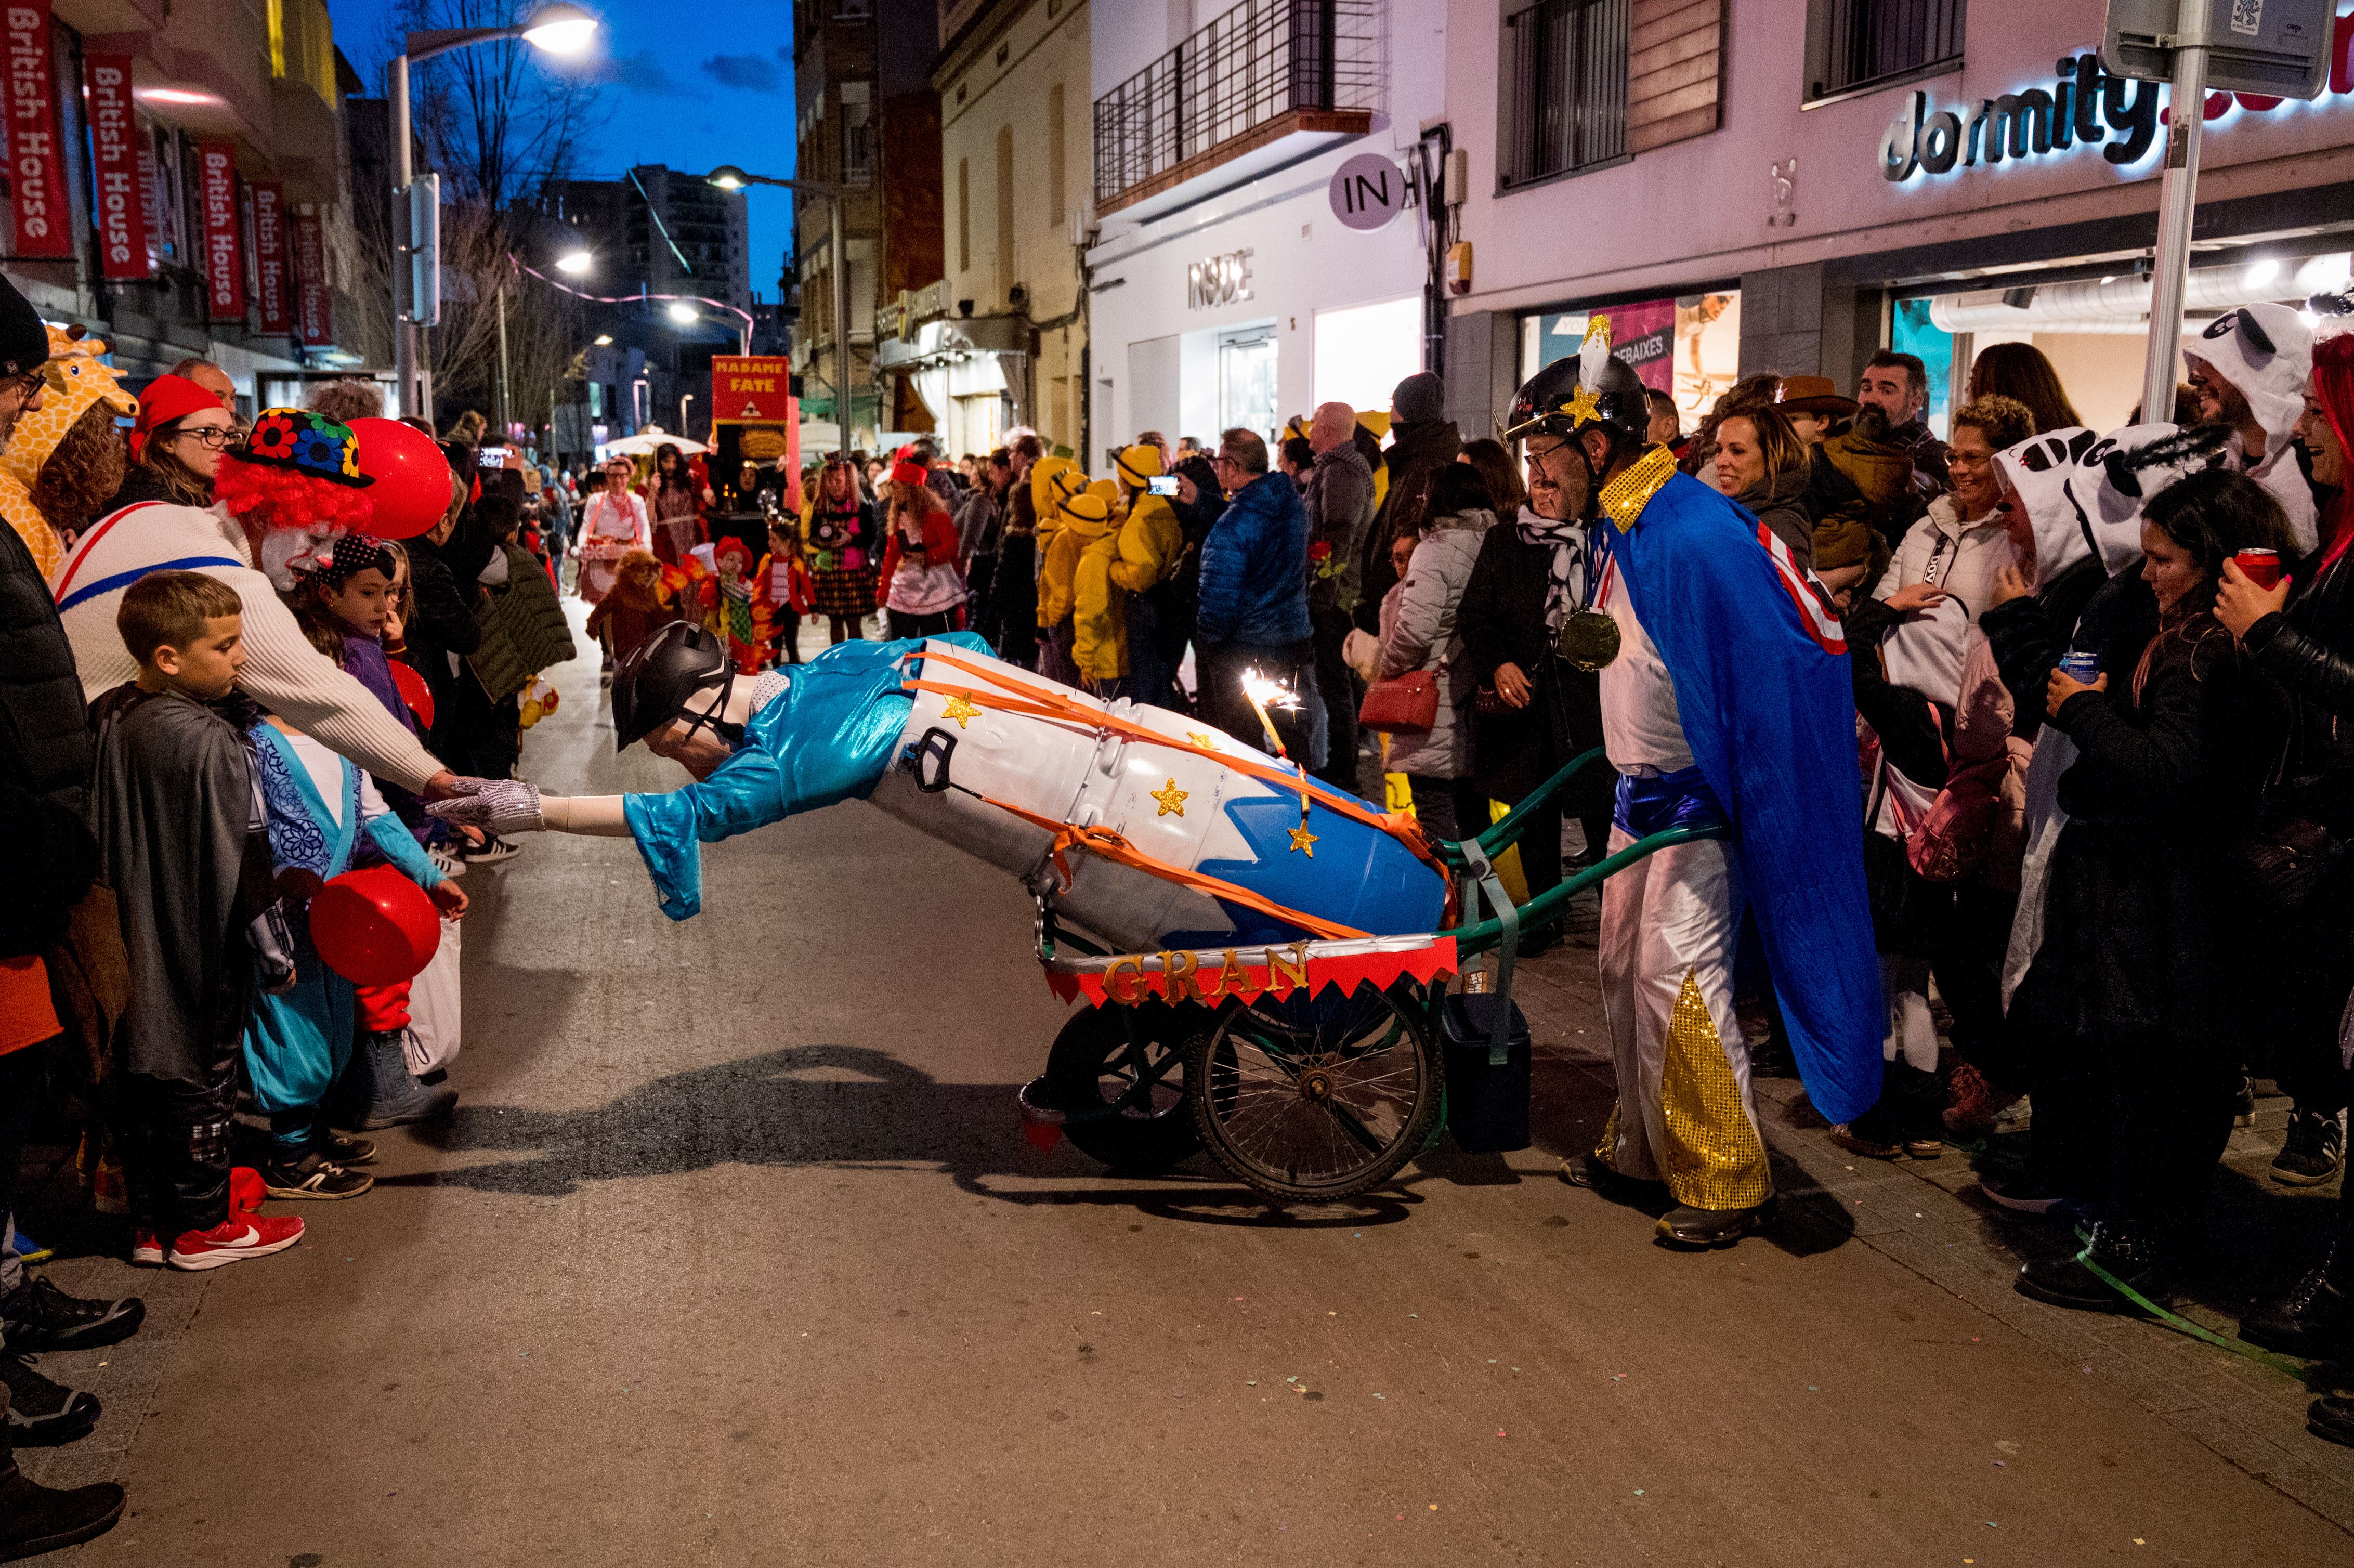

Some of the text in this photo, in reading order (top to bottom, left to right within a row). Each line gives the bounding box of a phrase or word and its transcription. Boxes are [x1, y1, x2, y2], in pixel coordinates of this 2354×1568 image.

[7, 7, 51, 239] British House
[95, 67, 131, 263] British House
[205, 153, 234, 306] British House
[1344, 171, 1389, 213] IN
[257, 190, 281, 323] British House
[716, 362, 783, 374] MADAME
[730, 378, 776, 393] FATE
[1102, 939, 1309, 1004] GRAN
